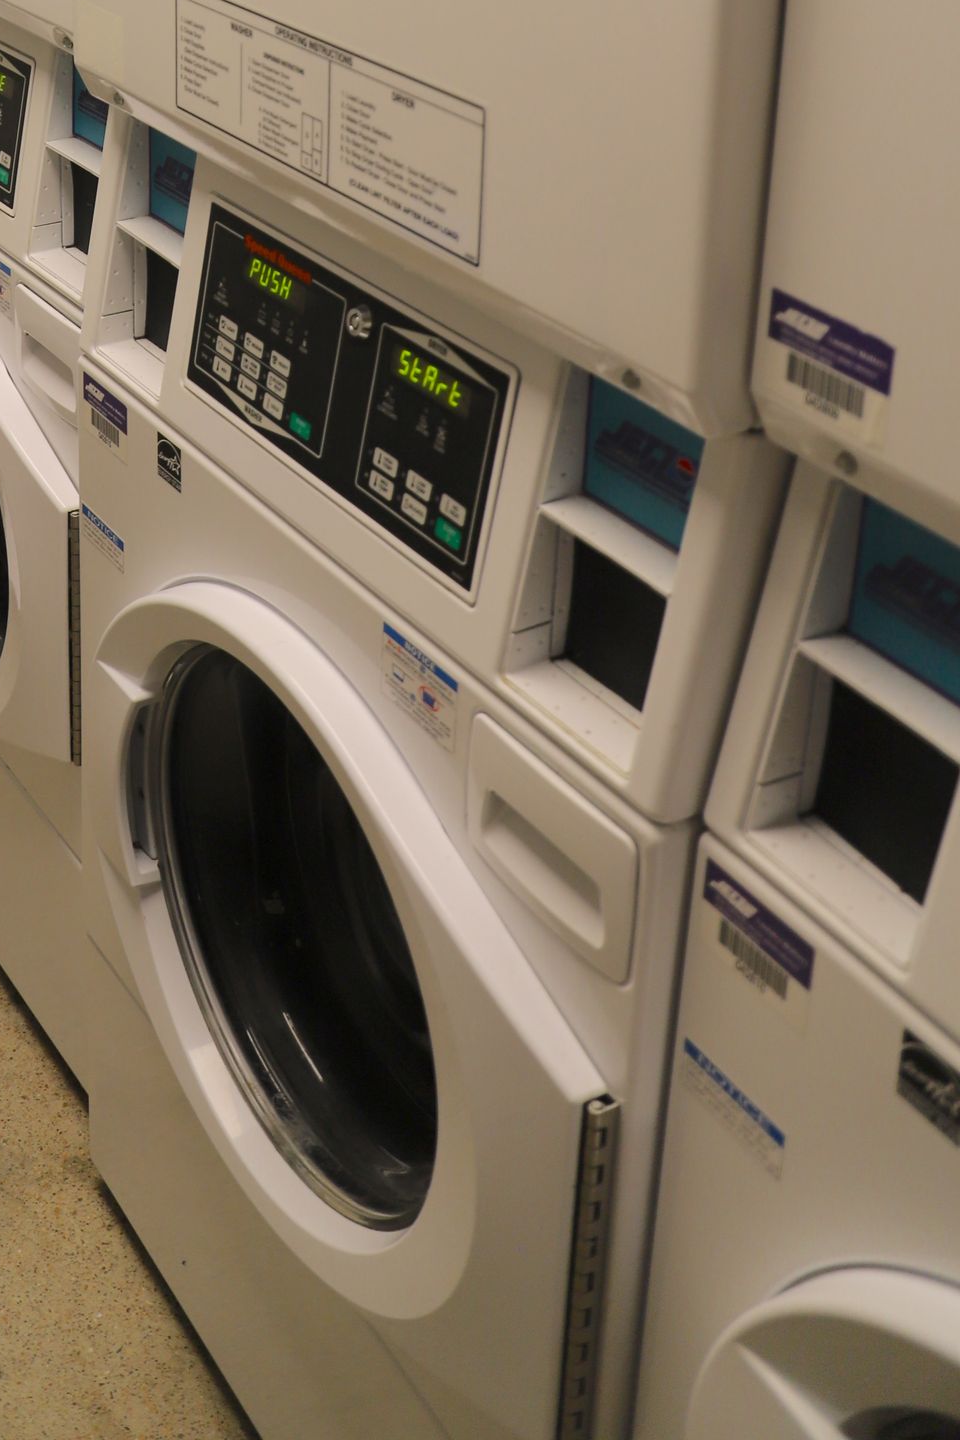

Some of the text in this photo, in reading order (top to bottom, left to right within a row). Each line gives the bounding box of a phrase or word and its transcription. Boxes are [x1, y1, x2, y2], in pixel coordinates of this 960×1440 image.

[249, 258, 292, 300] PUSH
[399, 349, 462, 408] StArt
[87, 510, 120, 546] NOTICE
